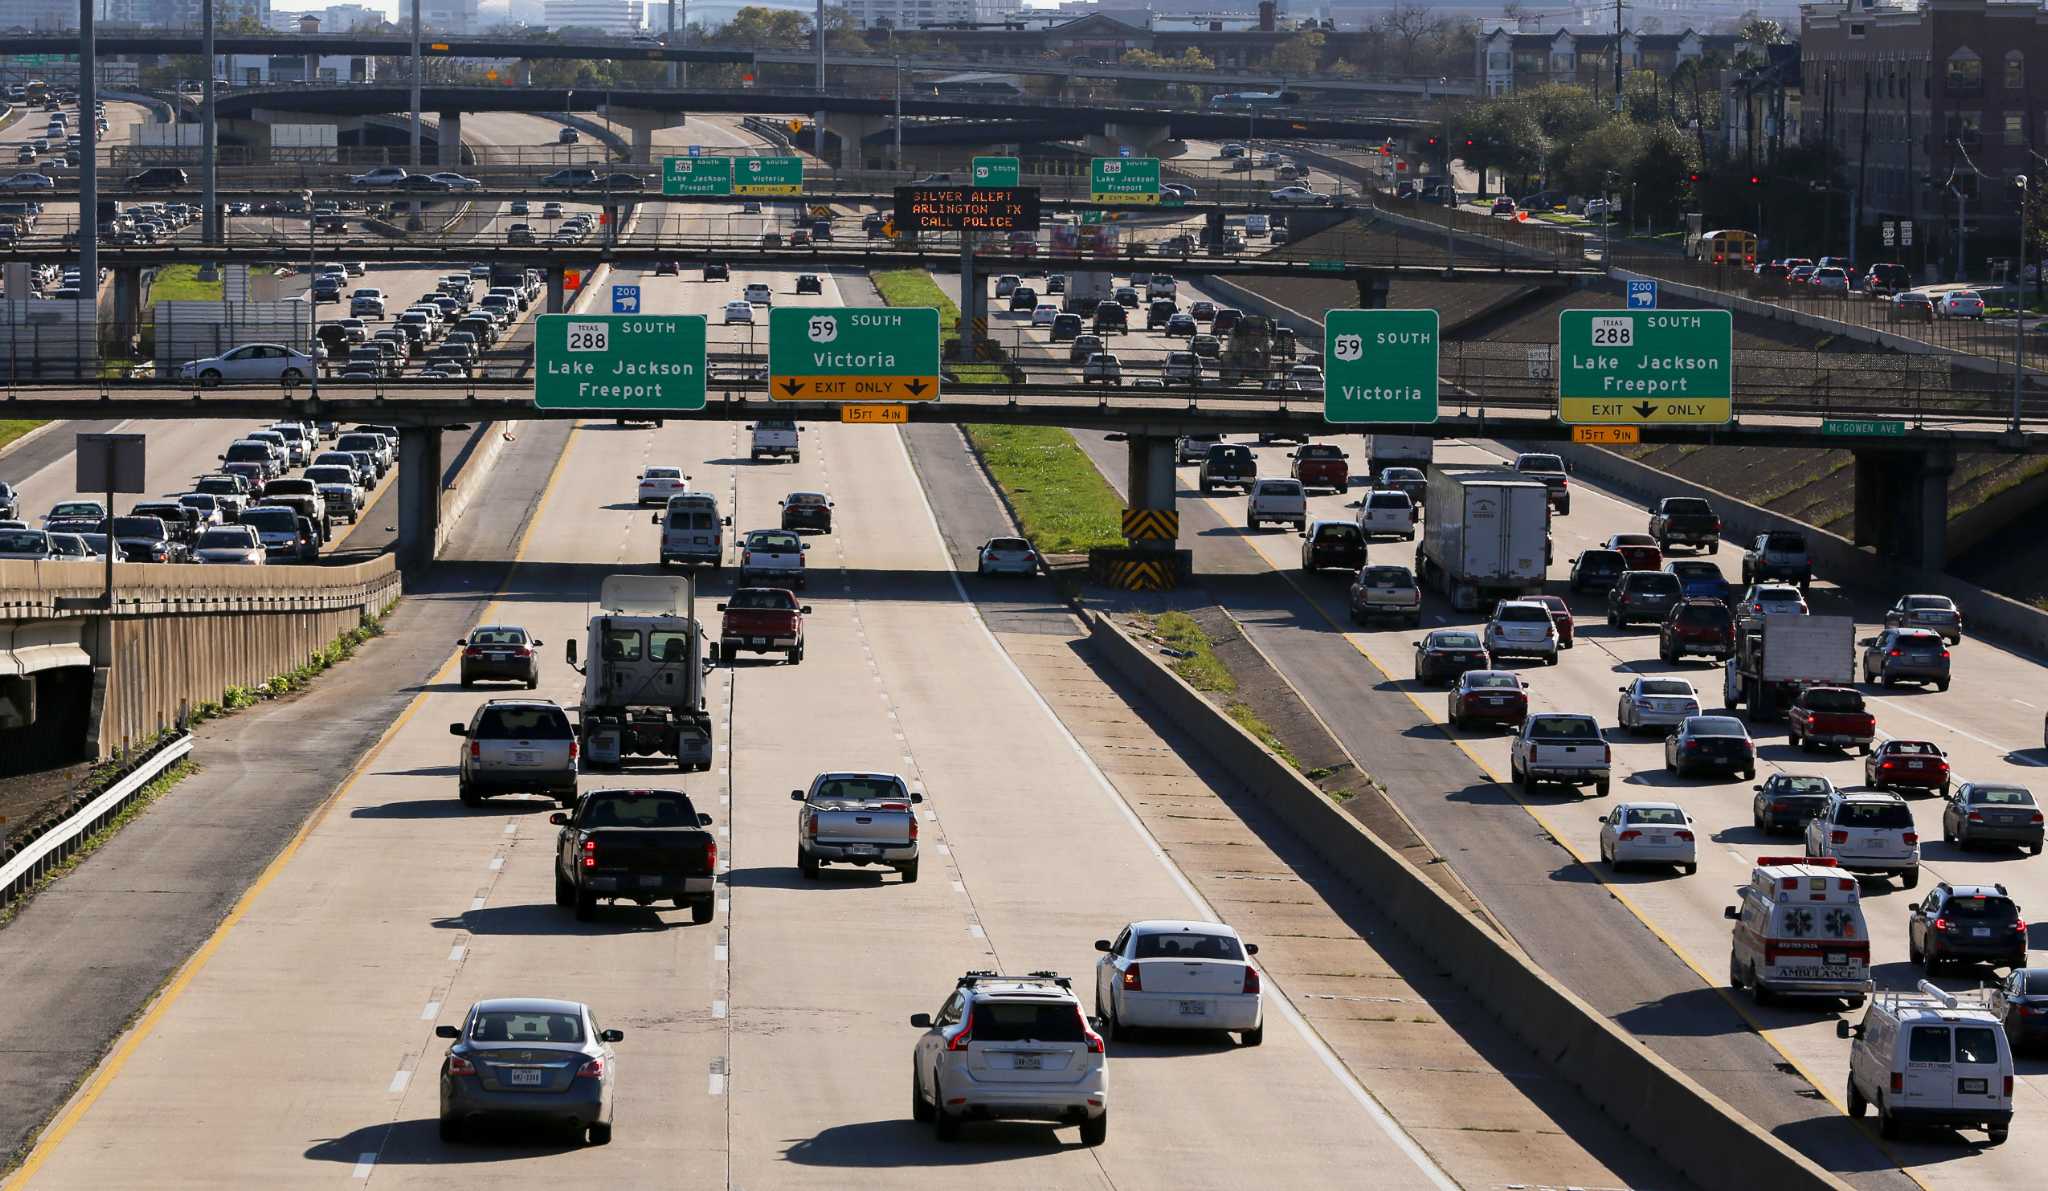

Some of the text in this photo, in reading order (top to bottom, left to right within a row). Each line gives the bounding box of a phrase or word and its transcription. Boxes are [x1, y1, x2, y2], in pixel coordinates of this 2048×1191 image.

[1108, 184, 1142, 192] Freeport
[913, 191, 1012, 202] SILVER ALERT
[912, 204, 1022, 215] ARLINGTON TX
[921, 216, 1013, 227] CALL POLICE
[616, 288, 636, 296] ZOO
[1632, 283, 1652, 291] ZOO
[851, 315, 902, 326] SOUTH
[1603, 319, 1623, 327] TEXAS
[1647, 317, 1702, 328] SOUTH
[622, 322, 676, 334] SOUTH
[811, 321, 835, 337] 59
[570, 333, 606, 349] 288
[1376, 333, 1431, 344] SOUTH
[1594, 328, 1630, 344] 288
[1337, 340, 1360, 355] 59
[813, 352, 896, 367] Victoria
[1573, 355, 1719, 369] Lake Jackson
[548, 360, 694, 375] Lake Jackson
[579, 382, 663, 400] Freeport
[815, 382, 893, 393] EXIT ONLY
[1603, 376, 1688, 394] Freeport
[1342, 386, 1422, 400] Victoria
[1592, 404, 1705, 416] EXIT ONLY
[1880, 422, 1897, 434] AVE
[1779, 968, 1855, 977] AMBULANCE
